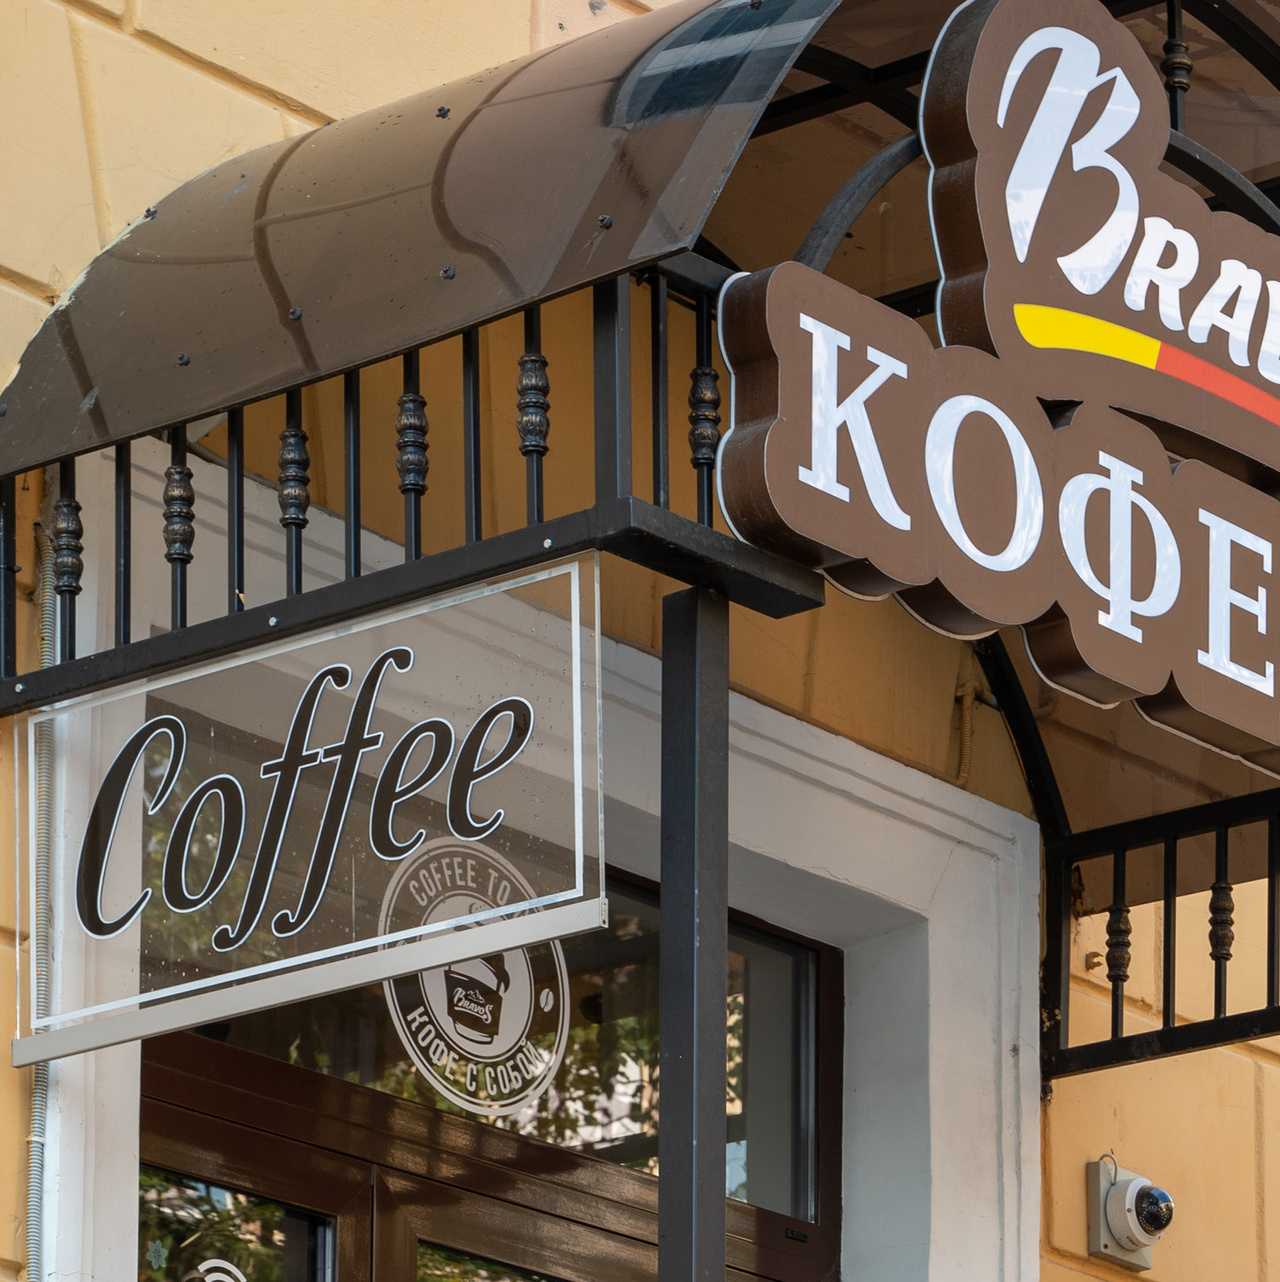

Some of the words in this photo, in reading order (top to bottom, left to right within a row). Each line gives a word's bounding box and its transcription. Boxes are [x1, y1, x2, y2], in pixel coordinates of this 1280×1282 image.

[76, 646, 534, 952] Coffee
[409, 857, 477, 907] COFFEE
[488, 868, 511, 906] TO
[406, 1005, 459, 1081] КОФЕ
[485, 1036, 548, 1096] СОБОЙ
